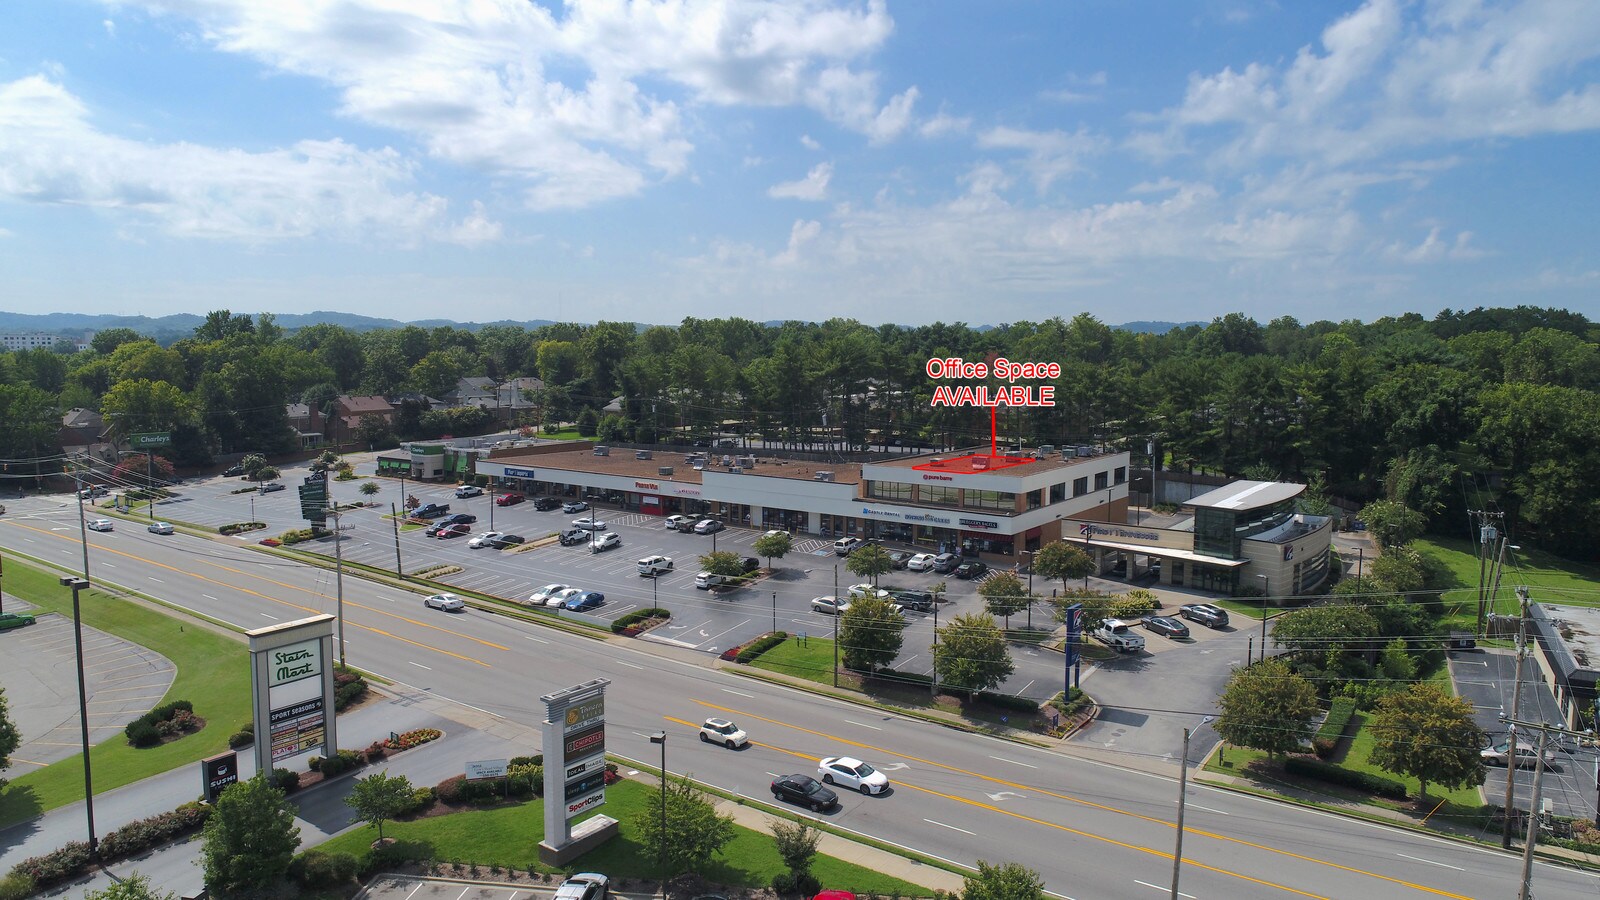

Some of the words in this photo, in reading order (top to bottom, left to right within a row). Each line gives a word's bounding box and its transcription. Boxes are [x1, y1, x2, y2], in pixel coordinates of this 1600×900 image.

[275, 649, 314, 665] Stein
[276, 663, 313, 681] Mart
[271, 710, 290, 721] SPORT
[575, 732, 602, 748] CHIPOTLE
[568, 766, 585, 777] IDEAL
[586, 759, 602, 769] IMAGE
[210, 774, 236, 788] SUSHI
